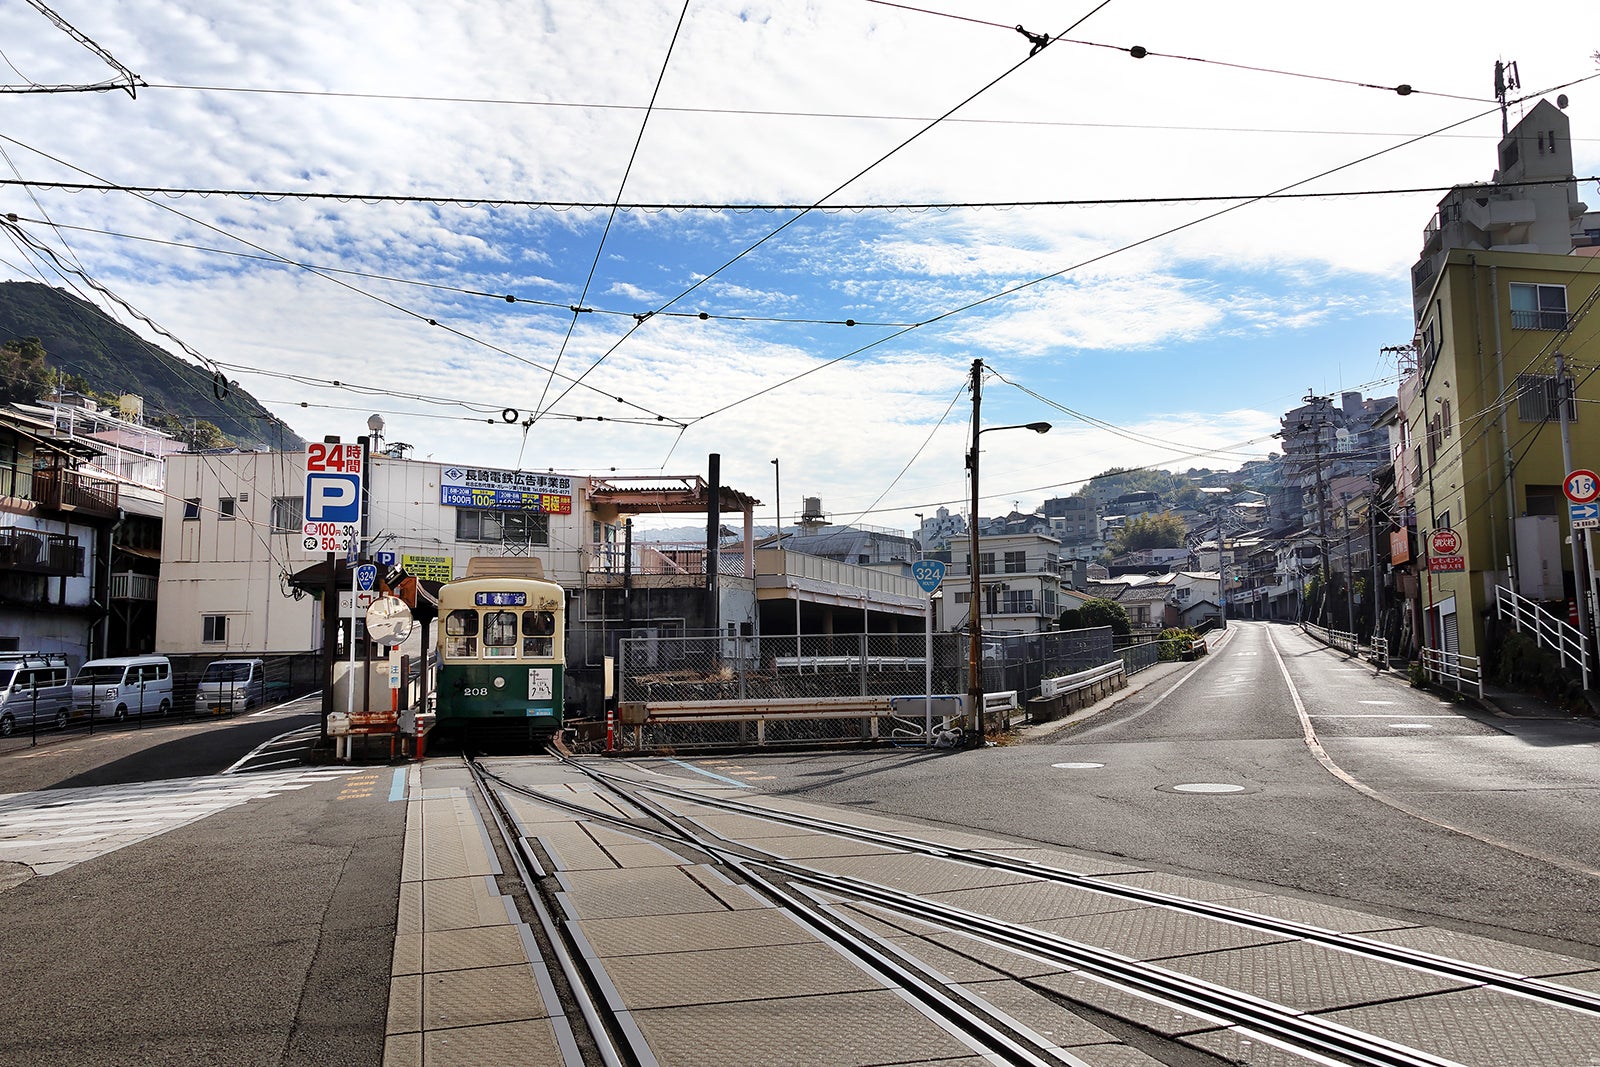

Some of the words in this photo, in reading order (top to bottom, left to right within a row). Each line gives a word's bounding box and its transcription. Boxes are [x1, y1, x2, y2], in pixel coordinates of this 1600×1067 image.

[307, 443, 345, 472] 24
[345, 445, 361, 473] 時間
[310, 477, 356, 518] P
[542, 494, 560, 512] 月極
[322, 538, 341, 551] 50円
[1434, 537, 1455, 548] 消火栓
[383, 554, 392, 565] P
[359, 571, 374, 582] 324
[916, 567, 941, 580] 324
[463, 687, 488, 696] 208
